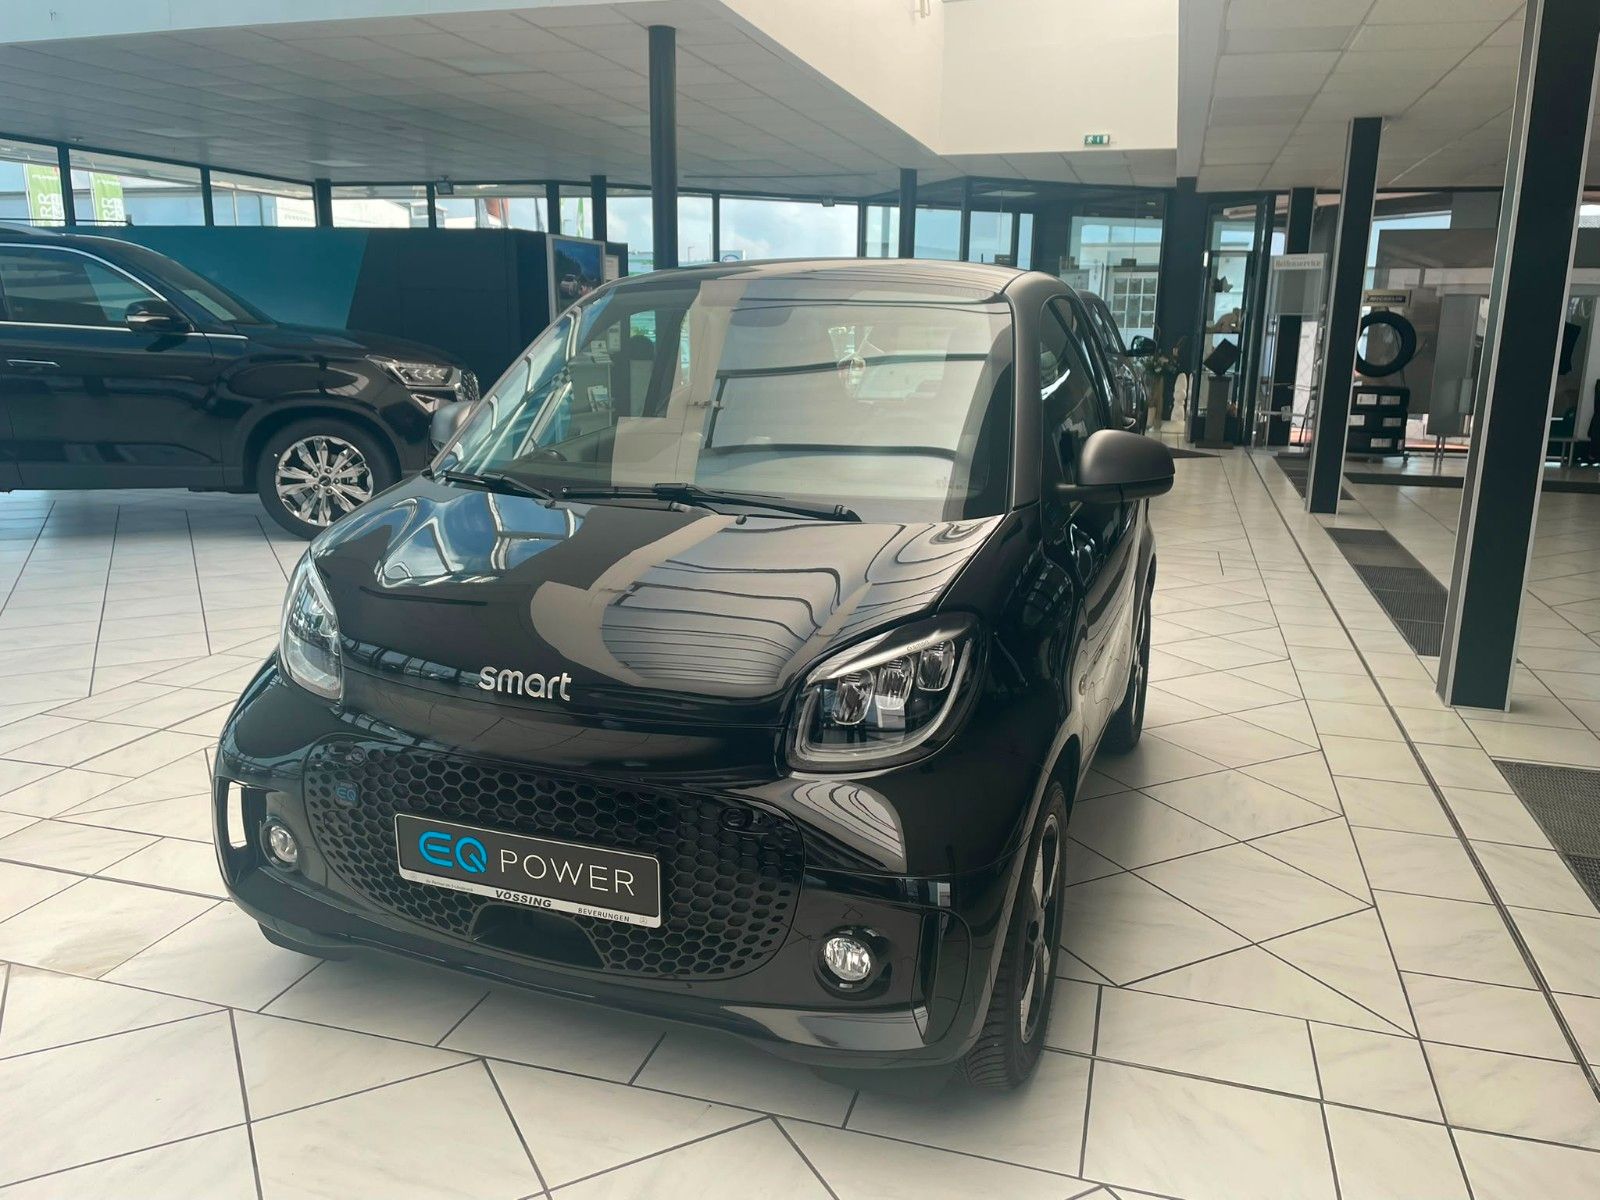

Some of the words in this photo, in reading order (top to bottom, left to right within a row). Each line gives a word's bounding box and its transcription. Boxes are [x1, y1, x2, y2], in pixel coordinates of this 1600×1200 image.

[478, 666, 572, 702] smart
[335, 786, 357, 801] EQ
[418, 830, 488, 874] EQ
[500, 848, 635, 897] POWER
[577, 907, 631, 922] BEVERUNGEN
